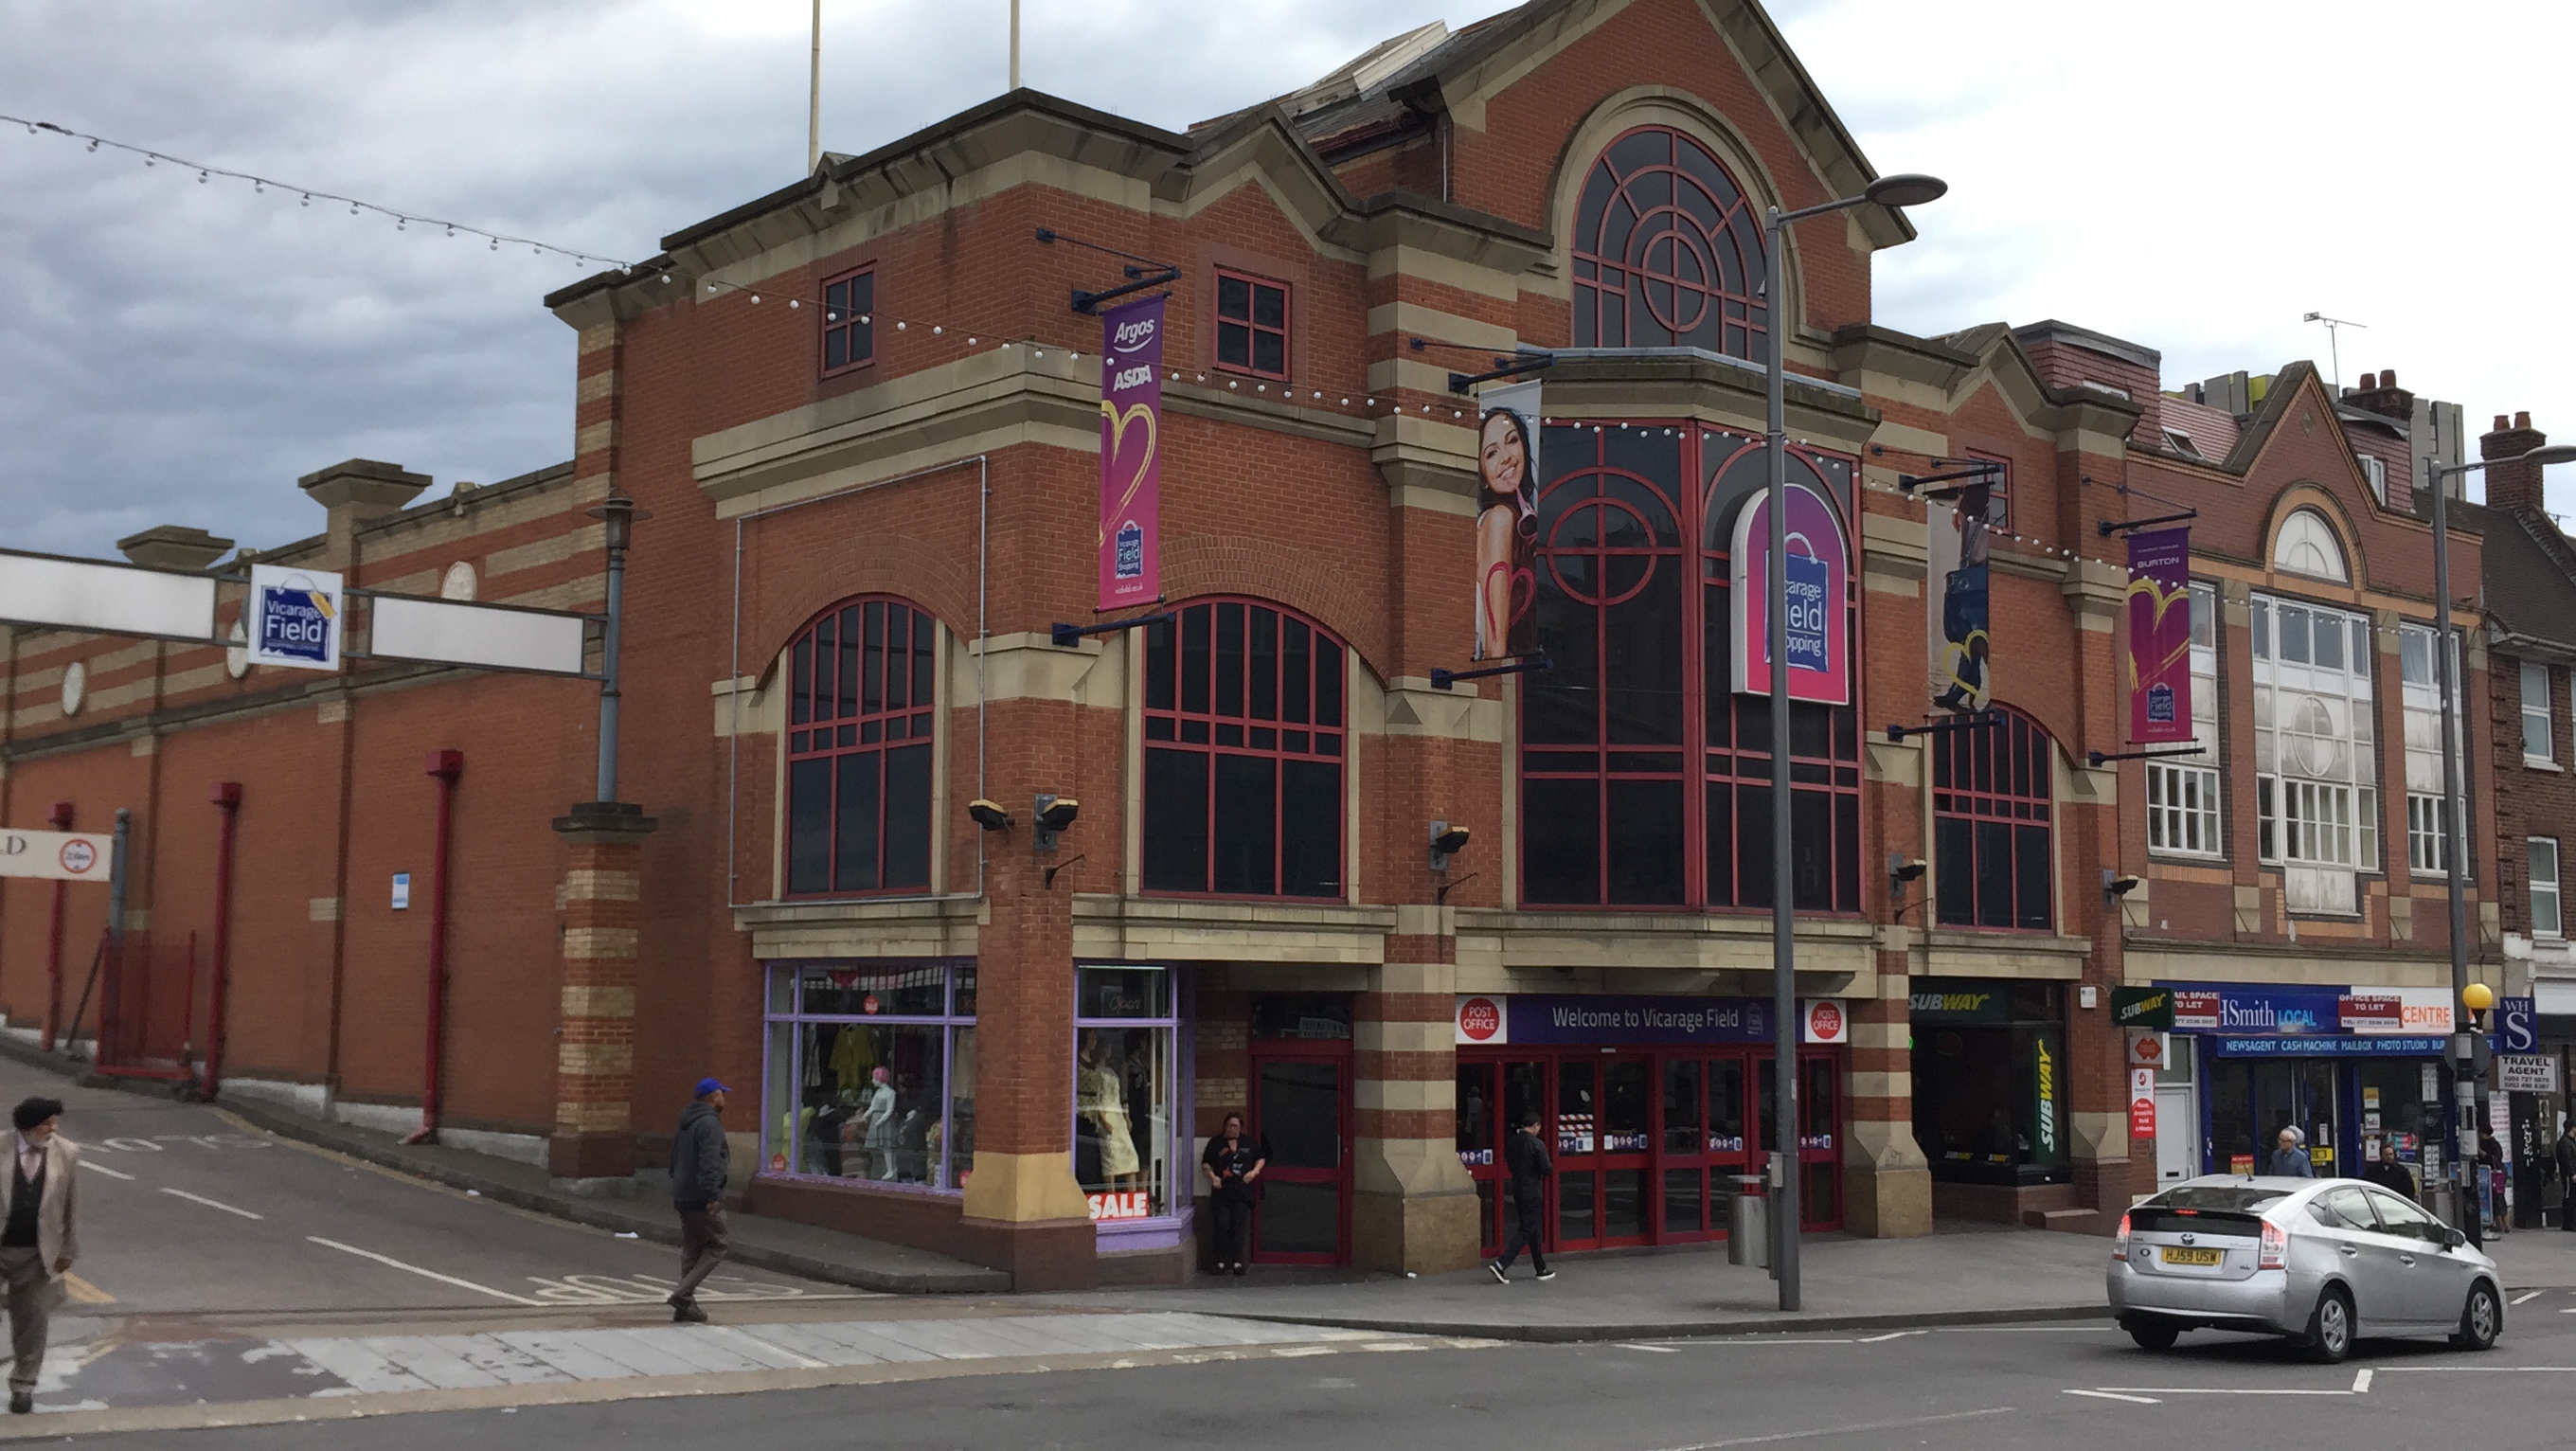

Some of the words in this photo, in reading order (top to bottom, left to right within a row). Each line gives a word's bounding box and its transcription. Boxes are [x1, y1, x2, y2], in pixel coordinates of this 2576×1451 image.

[1114, 319, 1154, 344] Argos
[1113, 365, 1153, 392] ASDA
[1118, 546, 1139, 562] Field
[2137, 557, 2179, 568] BURTON
[1785, 580, 1821, 601] arage
[267, 600, 322, 621] Vicarage
[1785, 598, 1822, 631] ield
[266, 615, 323, 642] Field
[1786, 635, 1821, 657] opping
[1909, 994, 1991, 1012] SUBWAY
[2120, 993, 2167, 1020] SUBWAY
[2339, 994, 2370, 1003] OFFICE
[2505, 1000, 2529, 1012] WH
[1469, 1007, 1491, 1017] POST
[1553, 1007, 1620, 1028] Welcome
[1624, 1009, 1639, 1028] to
[1642, 1009, 1704, 1033] Vicarage
[1707, 1009, 1739, 1028] Field
[1817, 1010, 1834, 1019] POST
[2219, 998, 2275, 1027] HSmith
[2277, 1010, 2317, 1027] LOCAL
[2402, 1007, 2450, 1024] CENTRE
[1463, 1018, 1494, 1030] OFFICE
[1814, 1020, 1838, 1030] OFFICE
[2506, 1012, 2531, 1050] S
[2227, 1040, 2276, 1051] NEWSAGENT
[2281, 1040, 2301, 1051] CASH
[2303, 1040, 2336, 1051] MACHINE
[2341, 1040, 2372, 1051] MAILBOX
[2377, 1040, 2401, 1051] PHOTO
[2403, 1040, 2428, 1051] STUDIO
[2502, 1057, 2550, 1066] TRAVEL
[2508, 1066, 2546, 1075] AGENT
[2038, 1039, 2054, 1153] SUBWAY
[1088, 1192, 1148, 1219] SALE
[2166, 1249, 2193, 1262] HJ59
